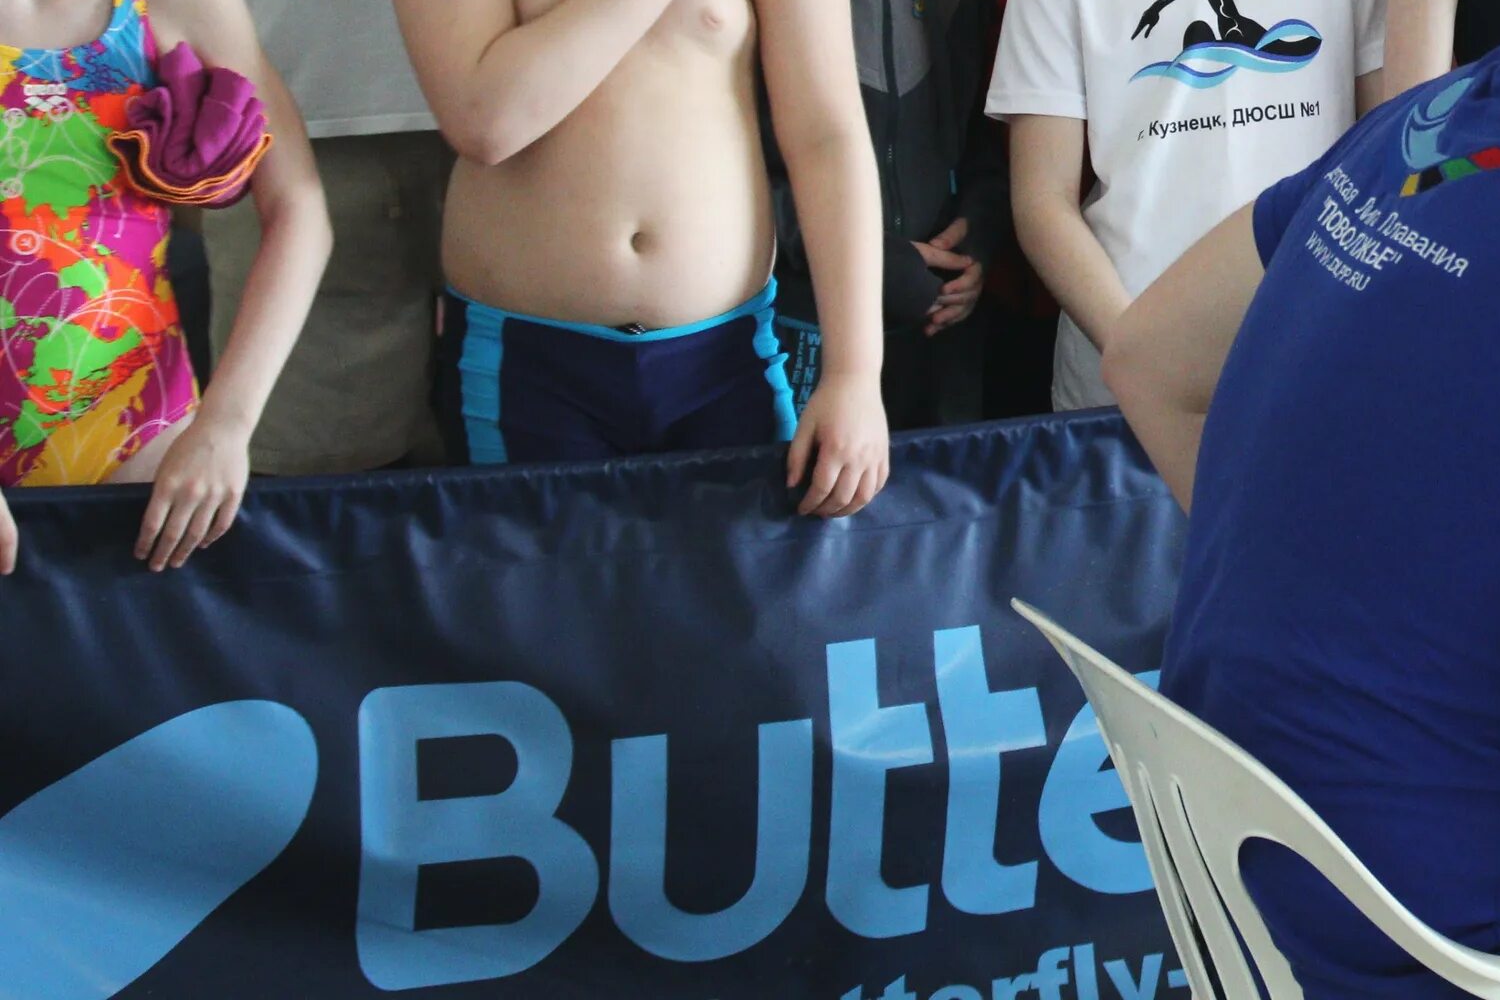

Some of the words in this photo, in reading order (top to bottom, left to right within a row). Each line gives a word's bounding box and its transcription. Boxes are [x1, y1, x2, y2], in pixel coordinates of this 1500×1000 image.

[1149, 115, 1226, 139] Кузнецк,
[1232, 103, 1295, 127] ДЮСШ
[1300, 100, 1320, 117] №1
[1377, 211, 1469, 277] Плавания
[355, 624, 1161, 991] Butte
